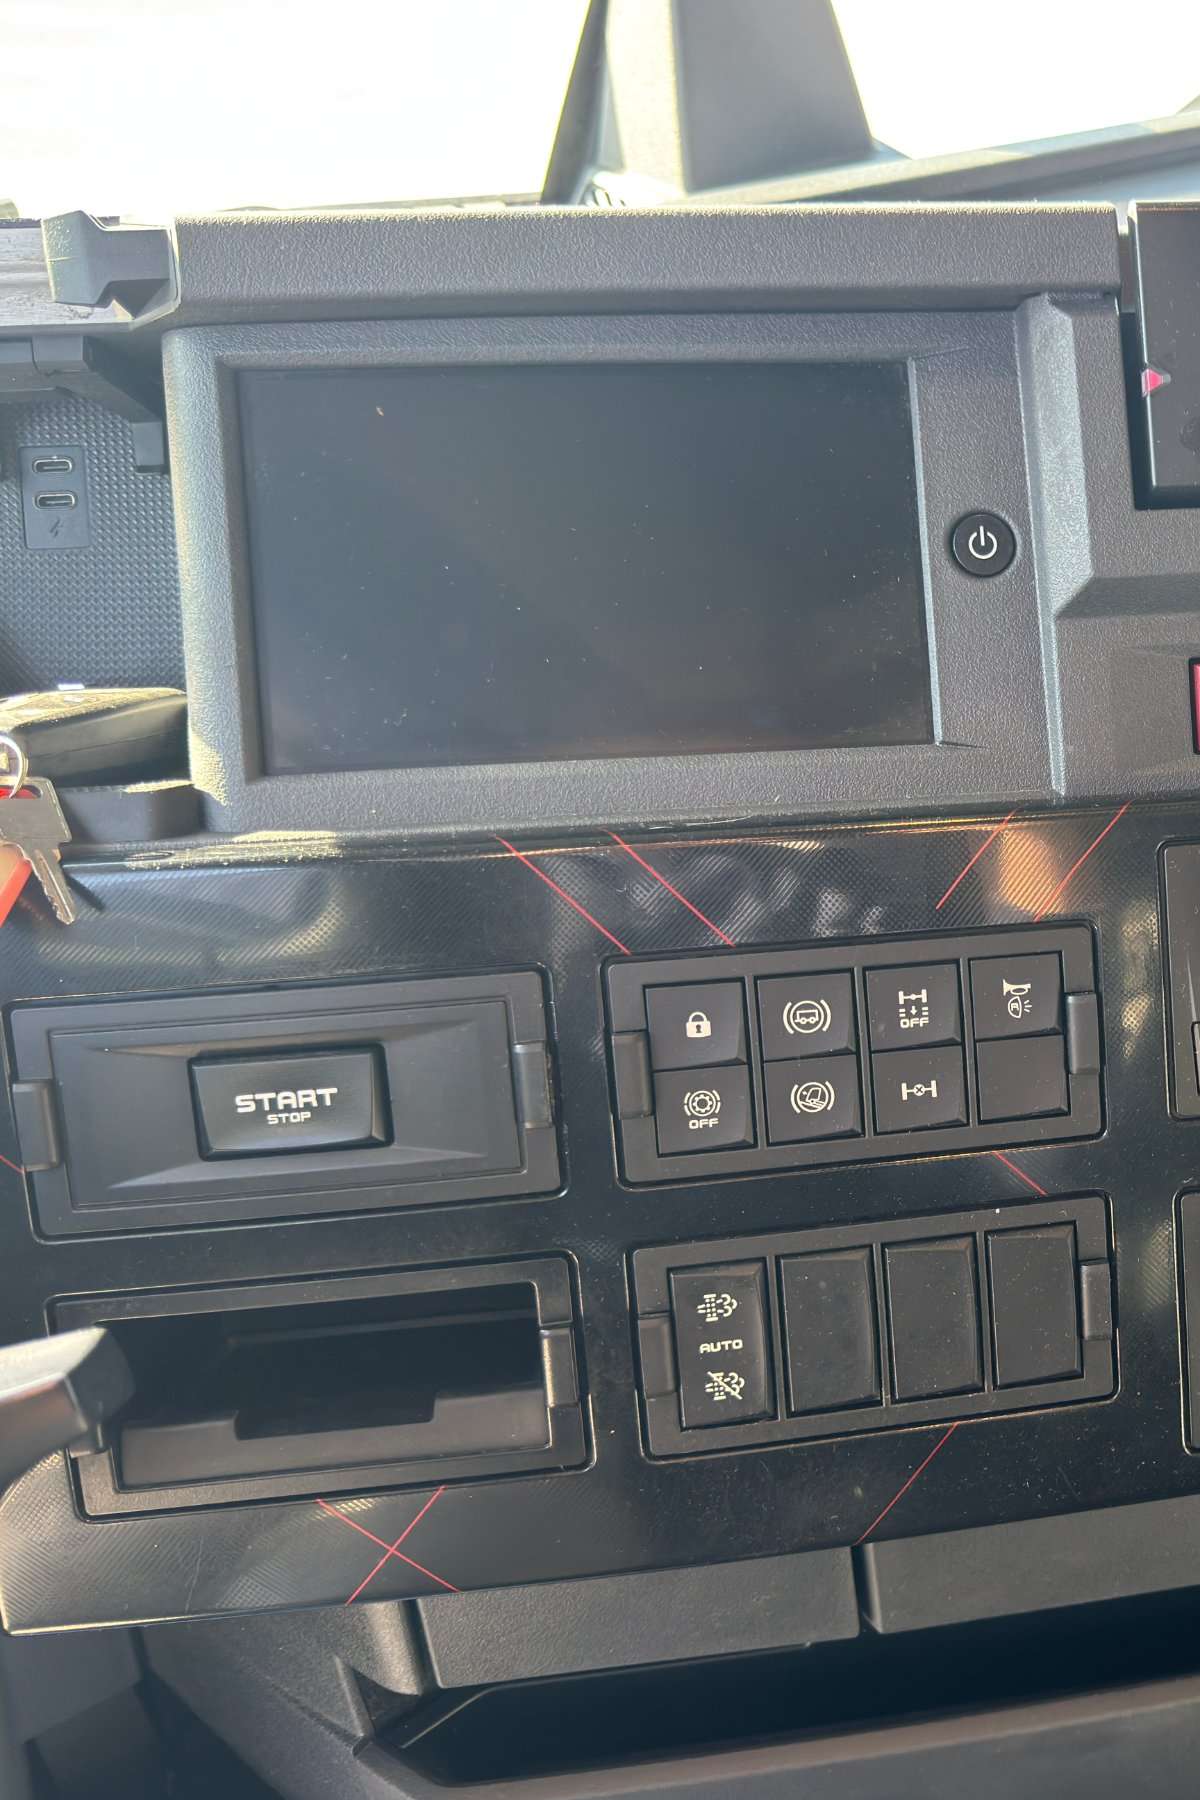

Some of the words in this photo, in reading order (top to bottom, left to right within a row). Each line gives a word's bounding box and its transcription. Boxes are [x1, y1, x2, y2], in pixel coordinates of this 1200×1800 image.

[899, 1018, 930, 1030] OFF
[234, 1087, 339, 1114] START
[265, 1111, 312, 1126] STOP
[688, 1117, 720, 1130] OFF
[699, 1338, 744, 1354] AUTO
